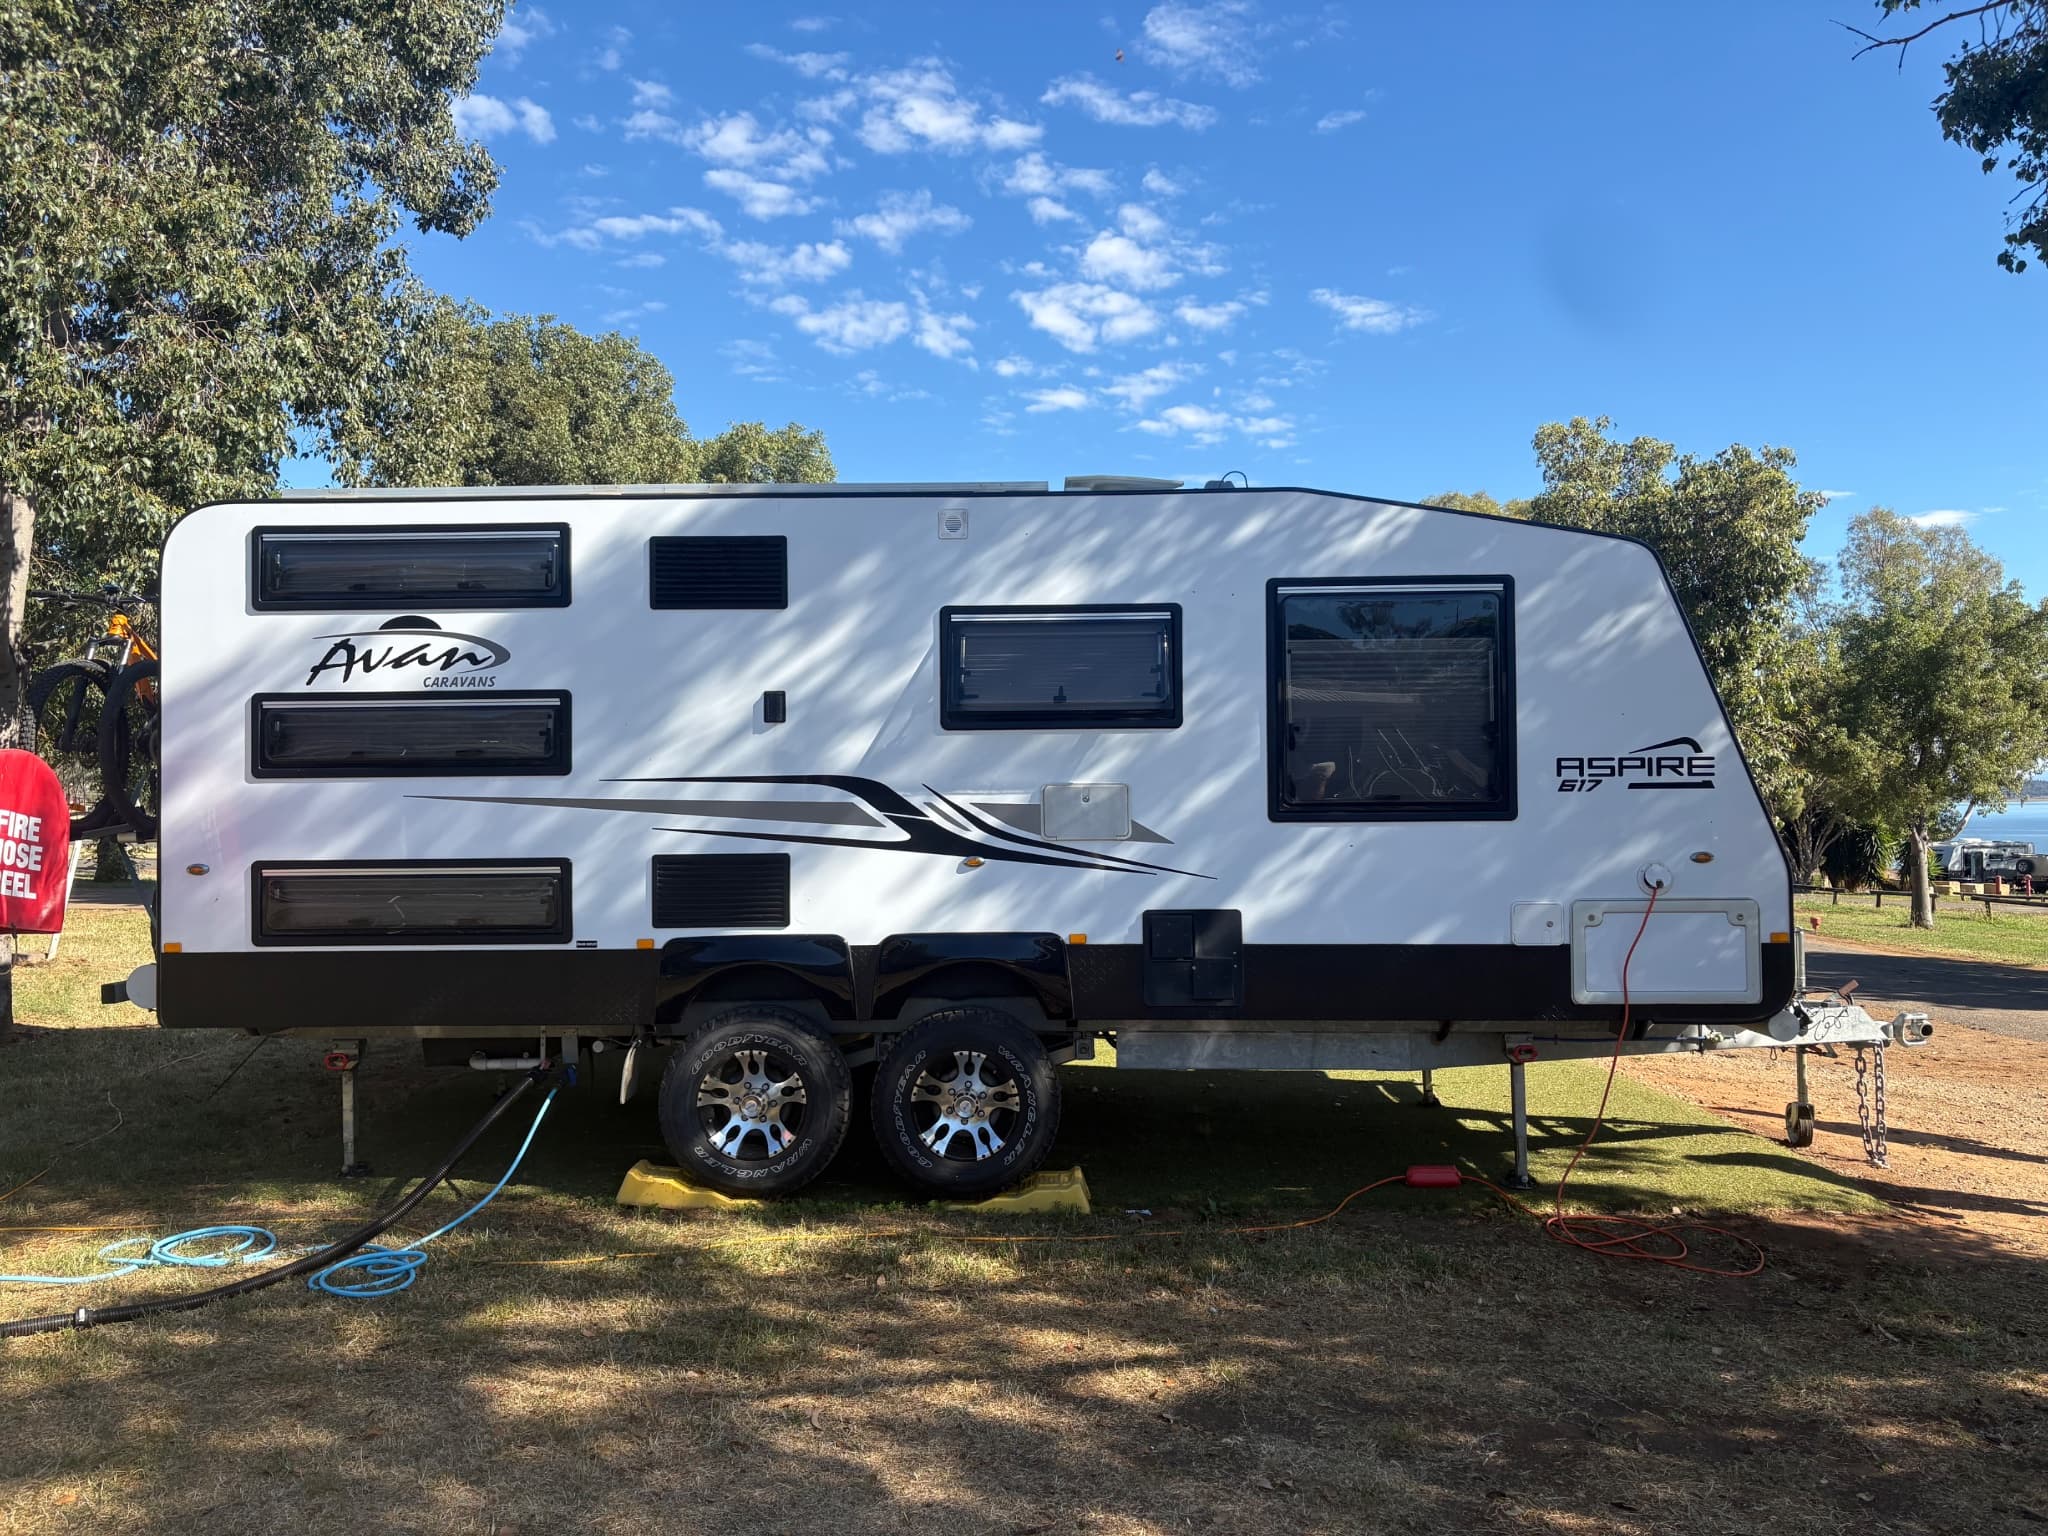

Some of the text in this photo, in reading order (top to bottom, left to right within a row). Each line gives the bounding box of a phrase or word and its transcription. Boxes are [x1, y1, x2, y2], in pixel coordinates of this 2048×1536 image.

[306, 638, 492, 686] Avan
[423, 676, 496, 687] CARAVANS
[1556, 757, 1715, 777] ASPIRE
[1557, 779, 1603, 792] 617
[0, 809, 41, 842] FIRE
[0, 869, 37, 899] EEL
[691, 1034, 808, 1075] GOODYEAR
[893, 1050, 933, 1168] GOODYEAR
[998, 1045, 1036, 1166] WRANGLER
[694, 1139, 812, 1179] WRANGLER
